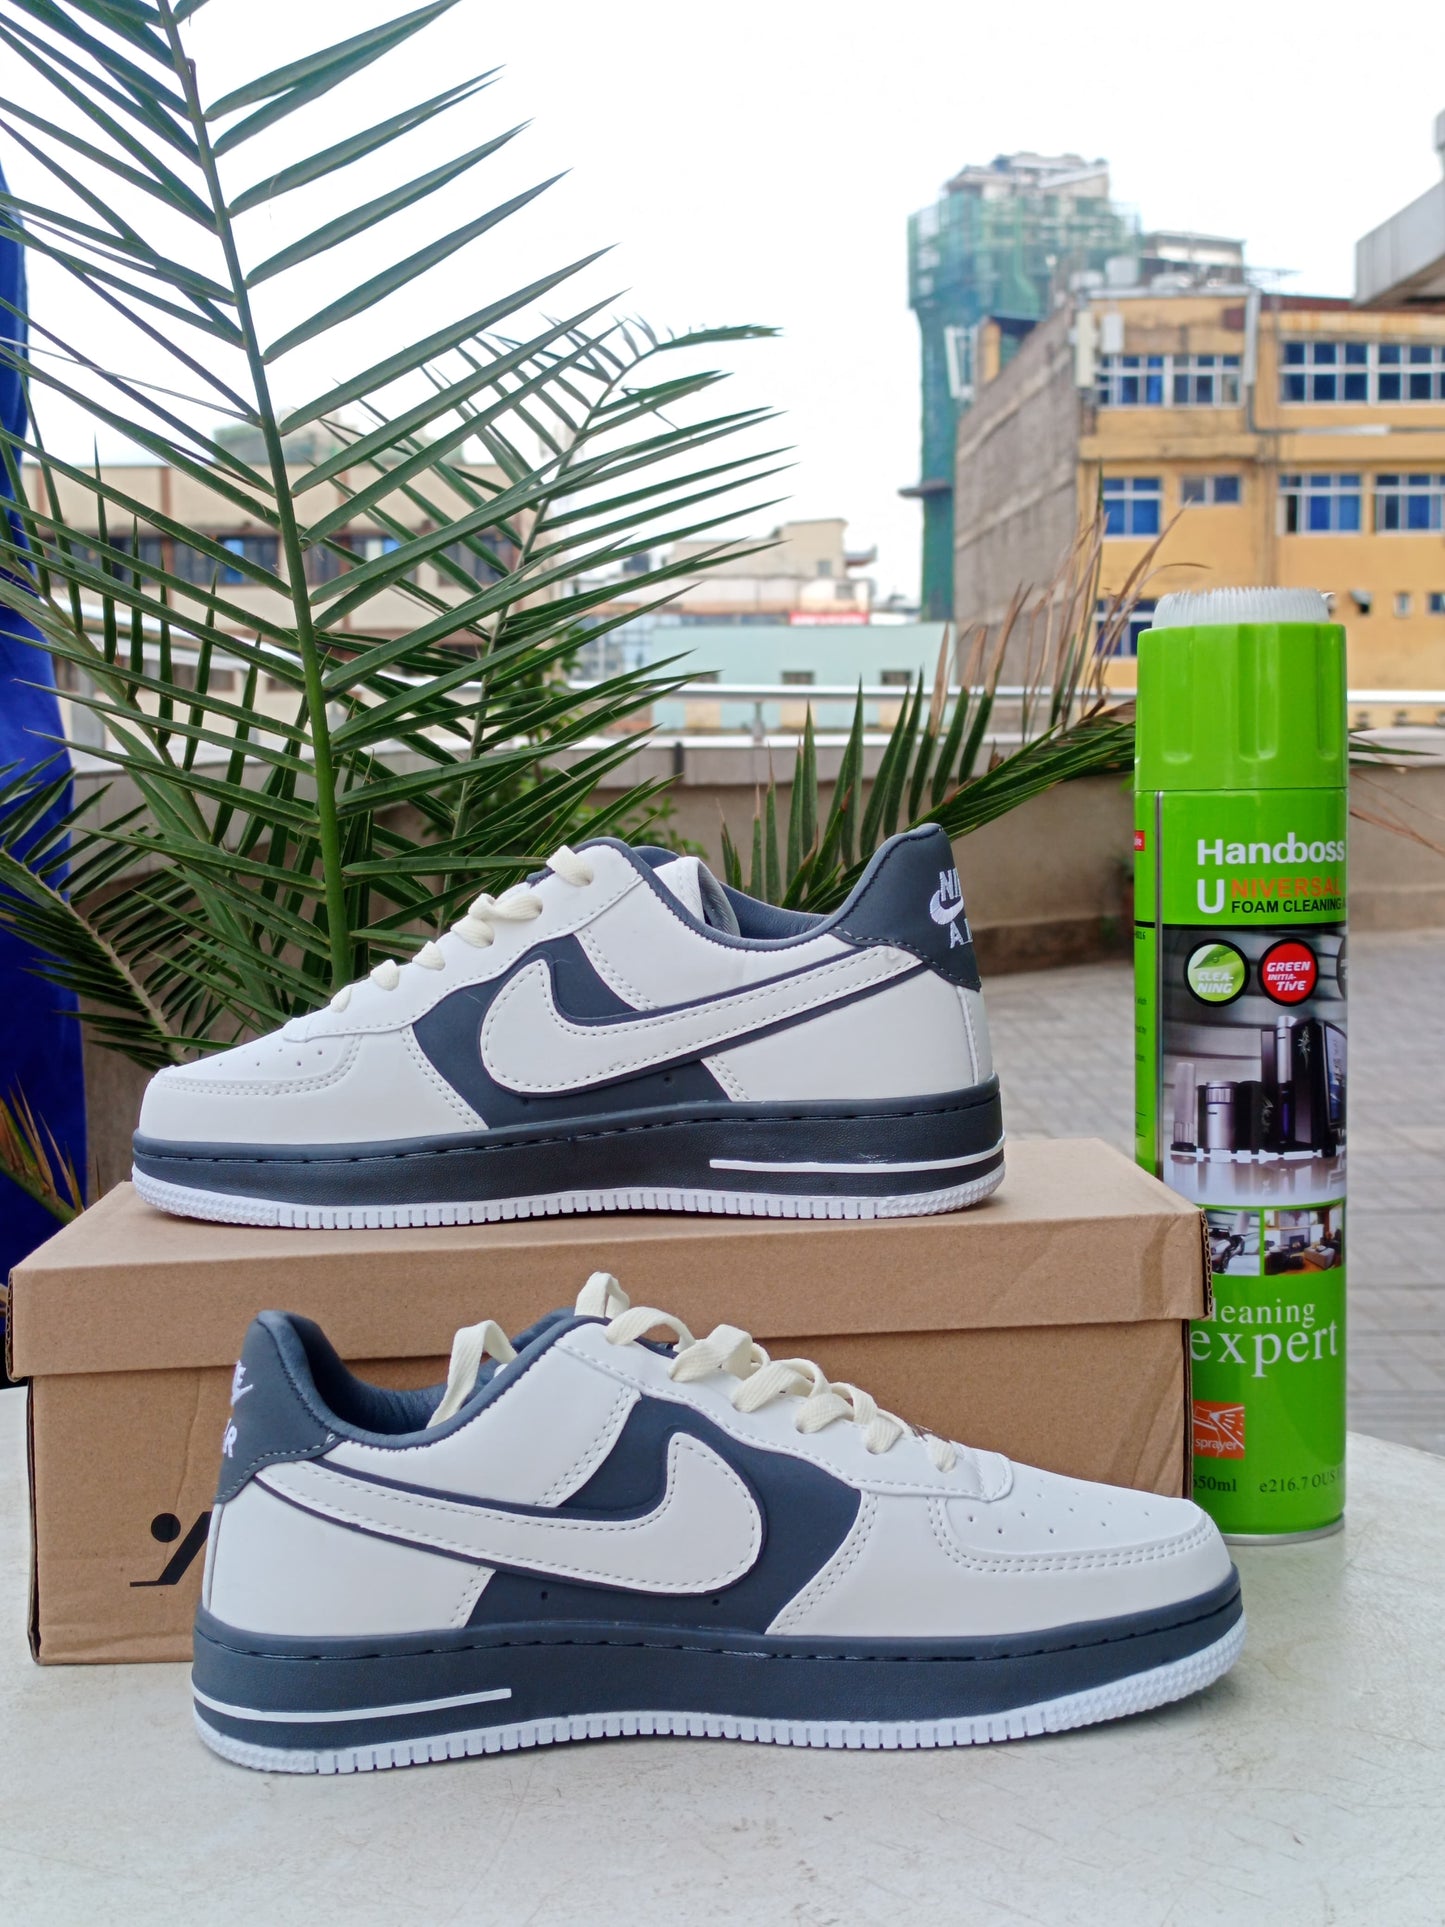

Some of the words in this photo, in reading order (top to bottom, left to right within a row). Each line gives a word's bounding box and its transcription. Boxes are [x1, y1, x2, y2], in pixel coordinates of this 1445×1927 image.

[1197, 831, 1345, 866] Handboss
[1231, 900, 1279, 913] FOAM
[1283, 897, 1342, 913] CLEANING
[1266, 960, 1311, 973] GREEN
[1197, 982, 1233, 995] NING
[1277, 980, 1307, 992] TIVE
[1211, 1297, 1316, 1329] leaning
[1190, 1319, 1338, 1378] expert
[1194, 1438, 1239, 1453] sprayer
